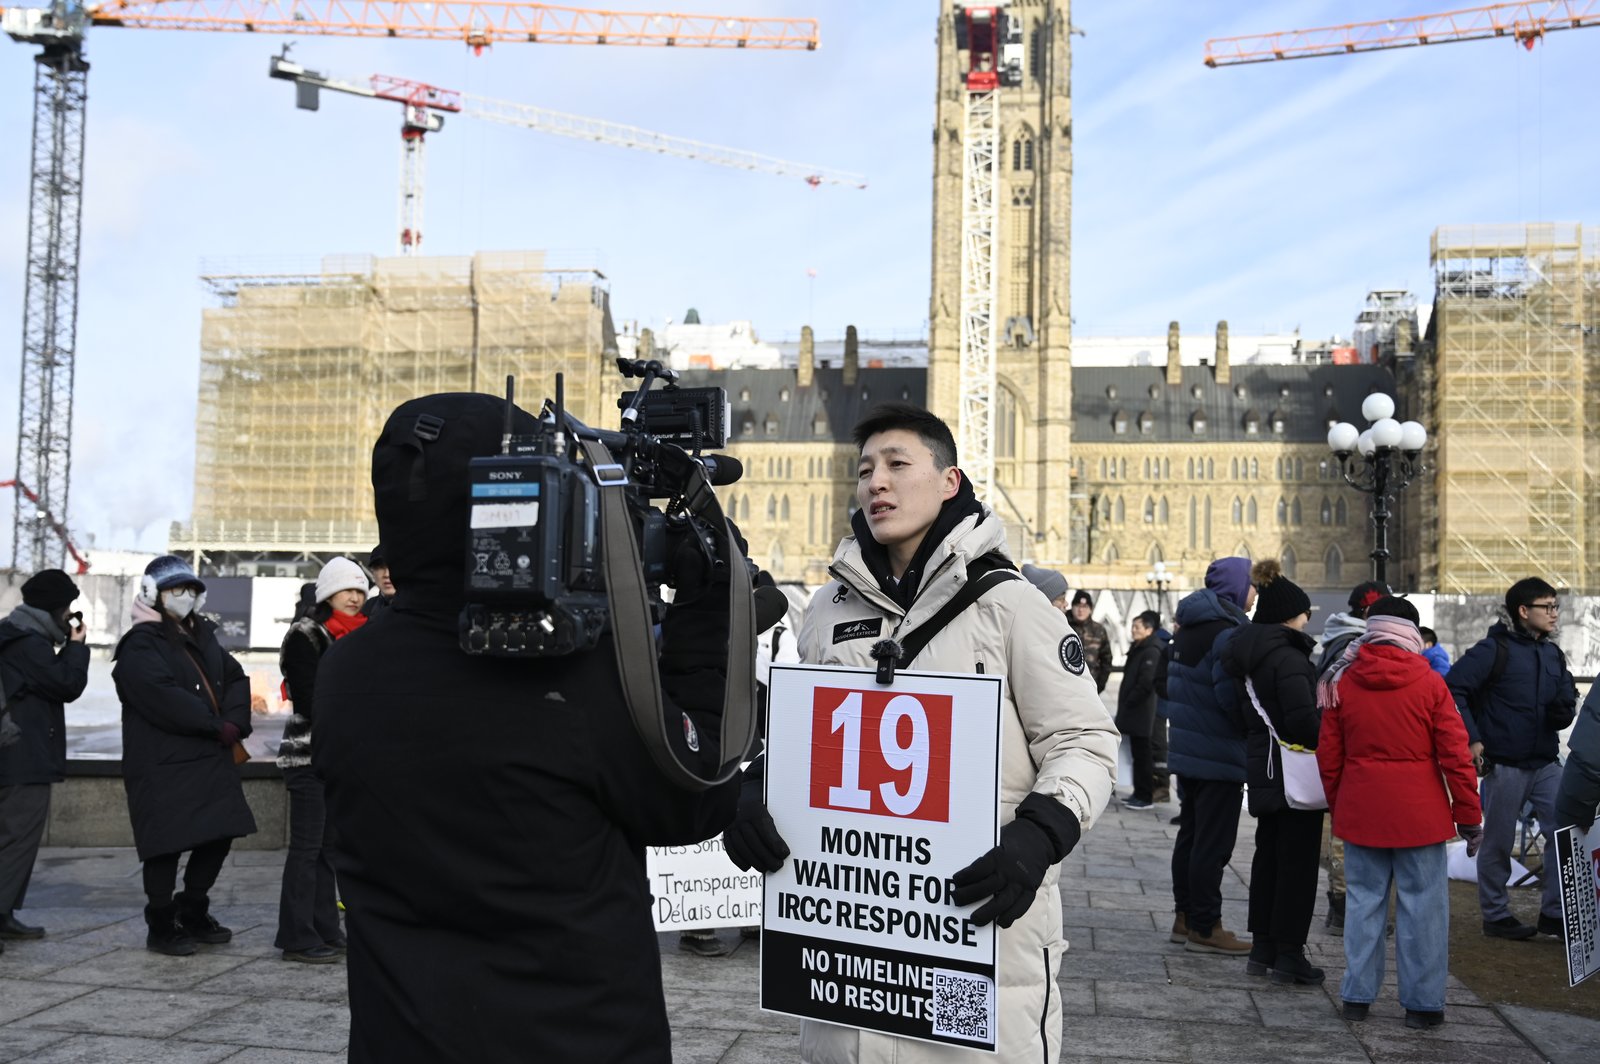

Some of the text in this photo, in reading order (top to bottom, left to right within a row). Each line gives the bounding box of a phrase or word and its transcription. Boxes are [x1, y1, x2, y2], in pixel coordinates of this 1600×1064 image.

[489, 471, 522, 480] SONY
[828, 691, 930, 816] 19
[821, 826, 931, 865] MONTHS
[1567, 856, 1573, 876] NO
[793, 858, 956, 906] WAITING FOR
[1562, 864, 1569, 884] NO
[1586, 861, 1598, 931] MONTHS
[658, 895, 712, 924] Délais
[778, 892, 977, 947] IRCC RESPONSE
[1573, 837, 1591, 966] IRCC RESPONSE
[1580, 845, 1595, 951] WAITING FOR
[802, 947, 934, 990] NO TIMELINE
[810, 978, 934, 1022] NO RESULTS
